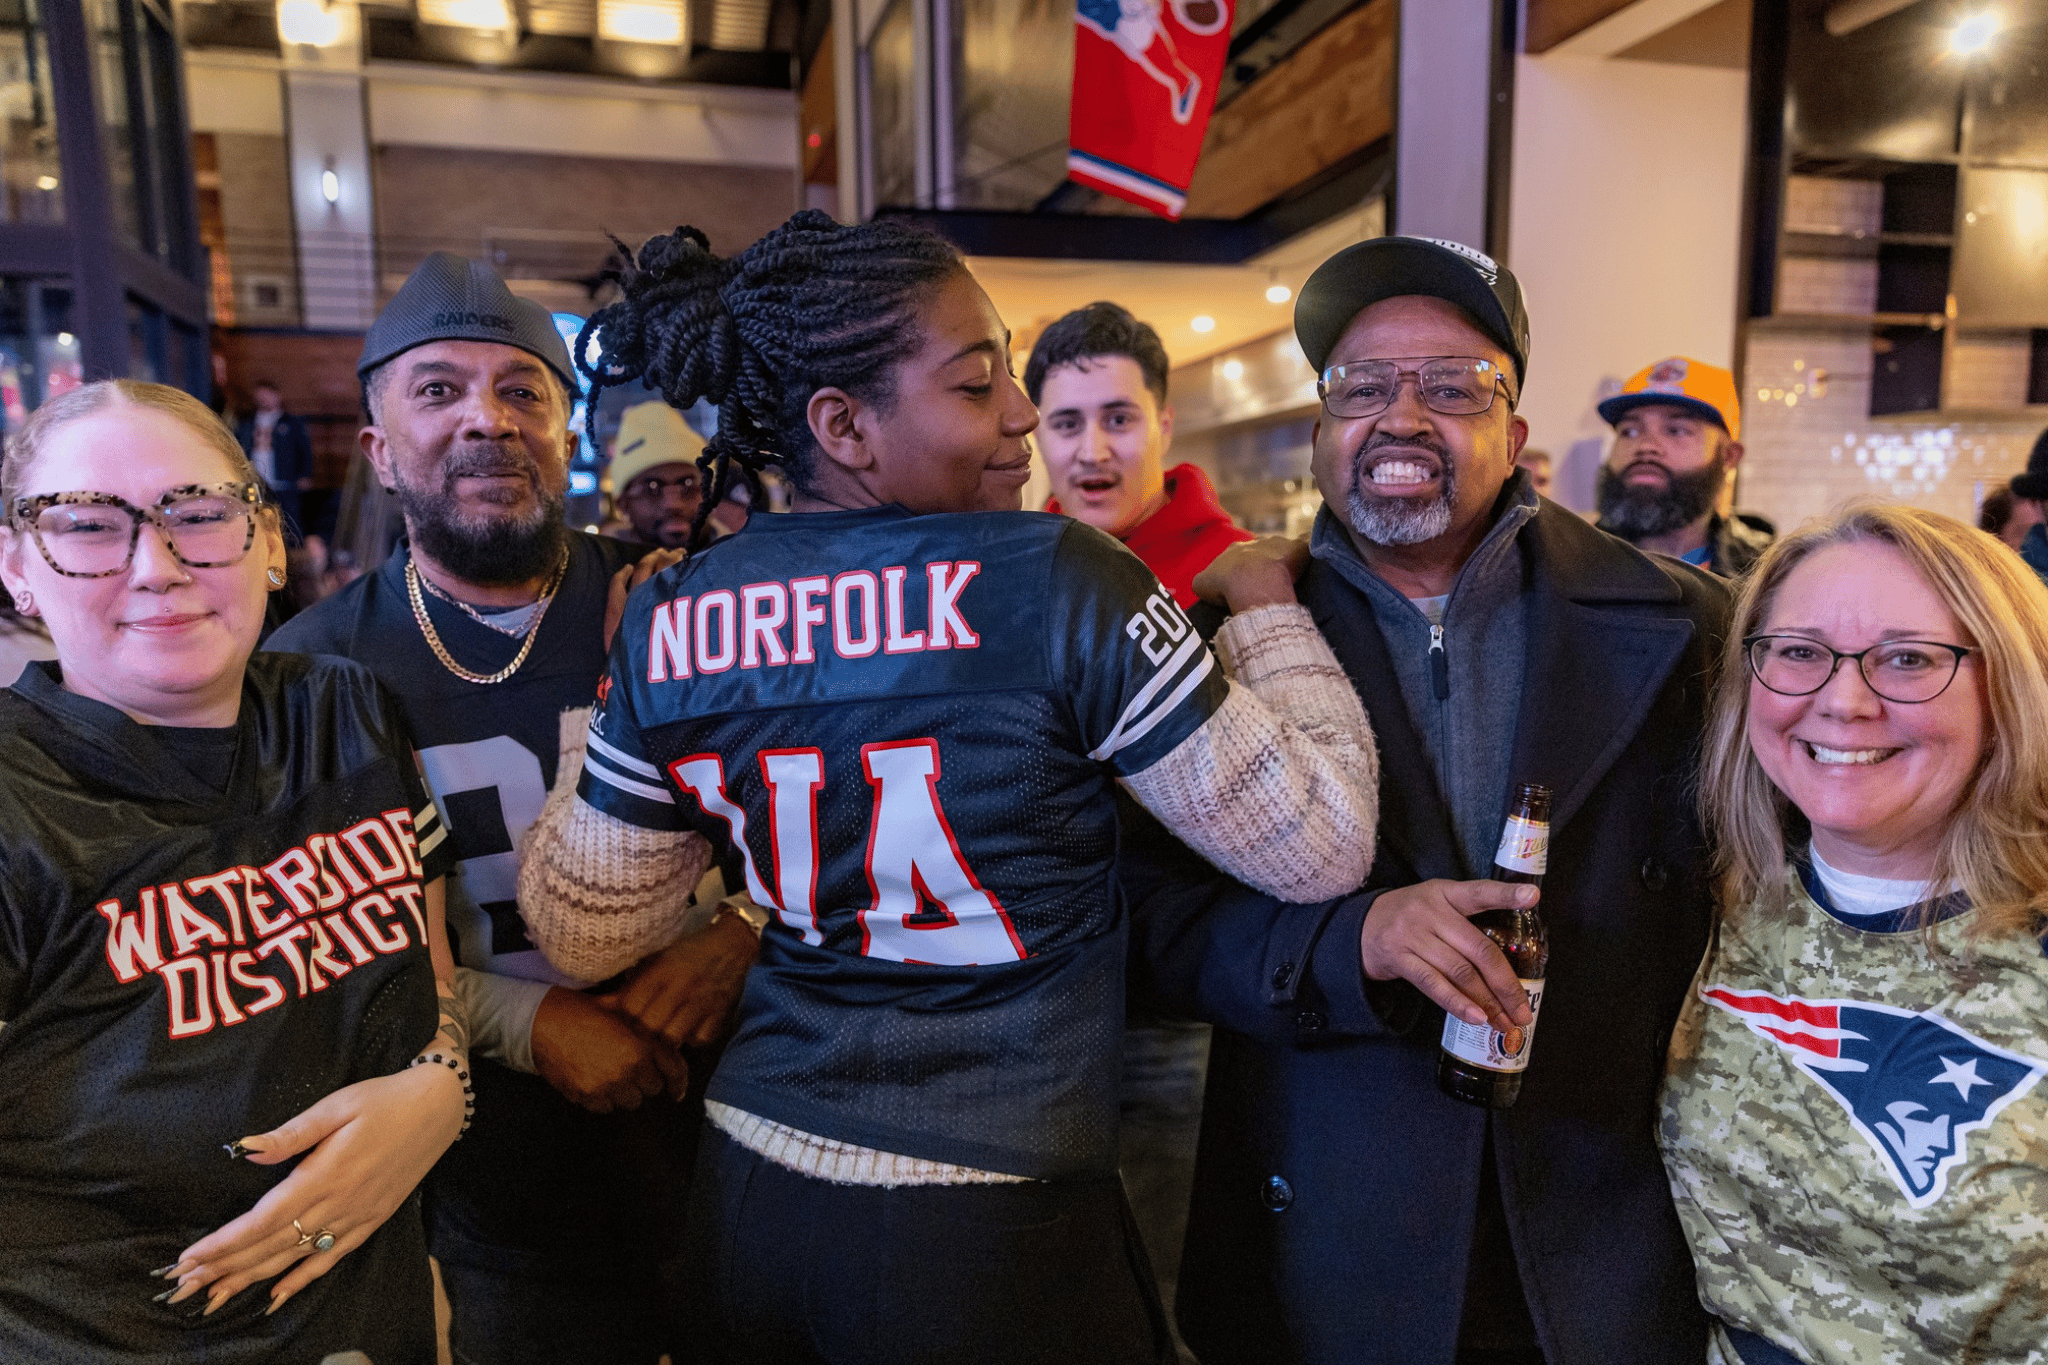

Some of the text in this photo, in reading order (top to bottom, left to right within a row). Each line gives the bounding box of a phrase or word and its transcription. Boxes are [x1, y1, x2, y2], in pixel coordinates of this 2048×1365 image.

[434, 310, 515, 332] RAIDERS
[647, 560, 980, 684] NORFOLK
[1126, 582, 1192, 667] 20
[668, 737, 1028, 966] VA
[157, 882, 429, 1040] DISTRICT
